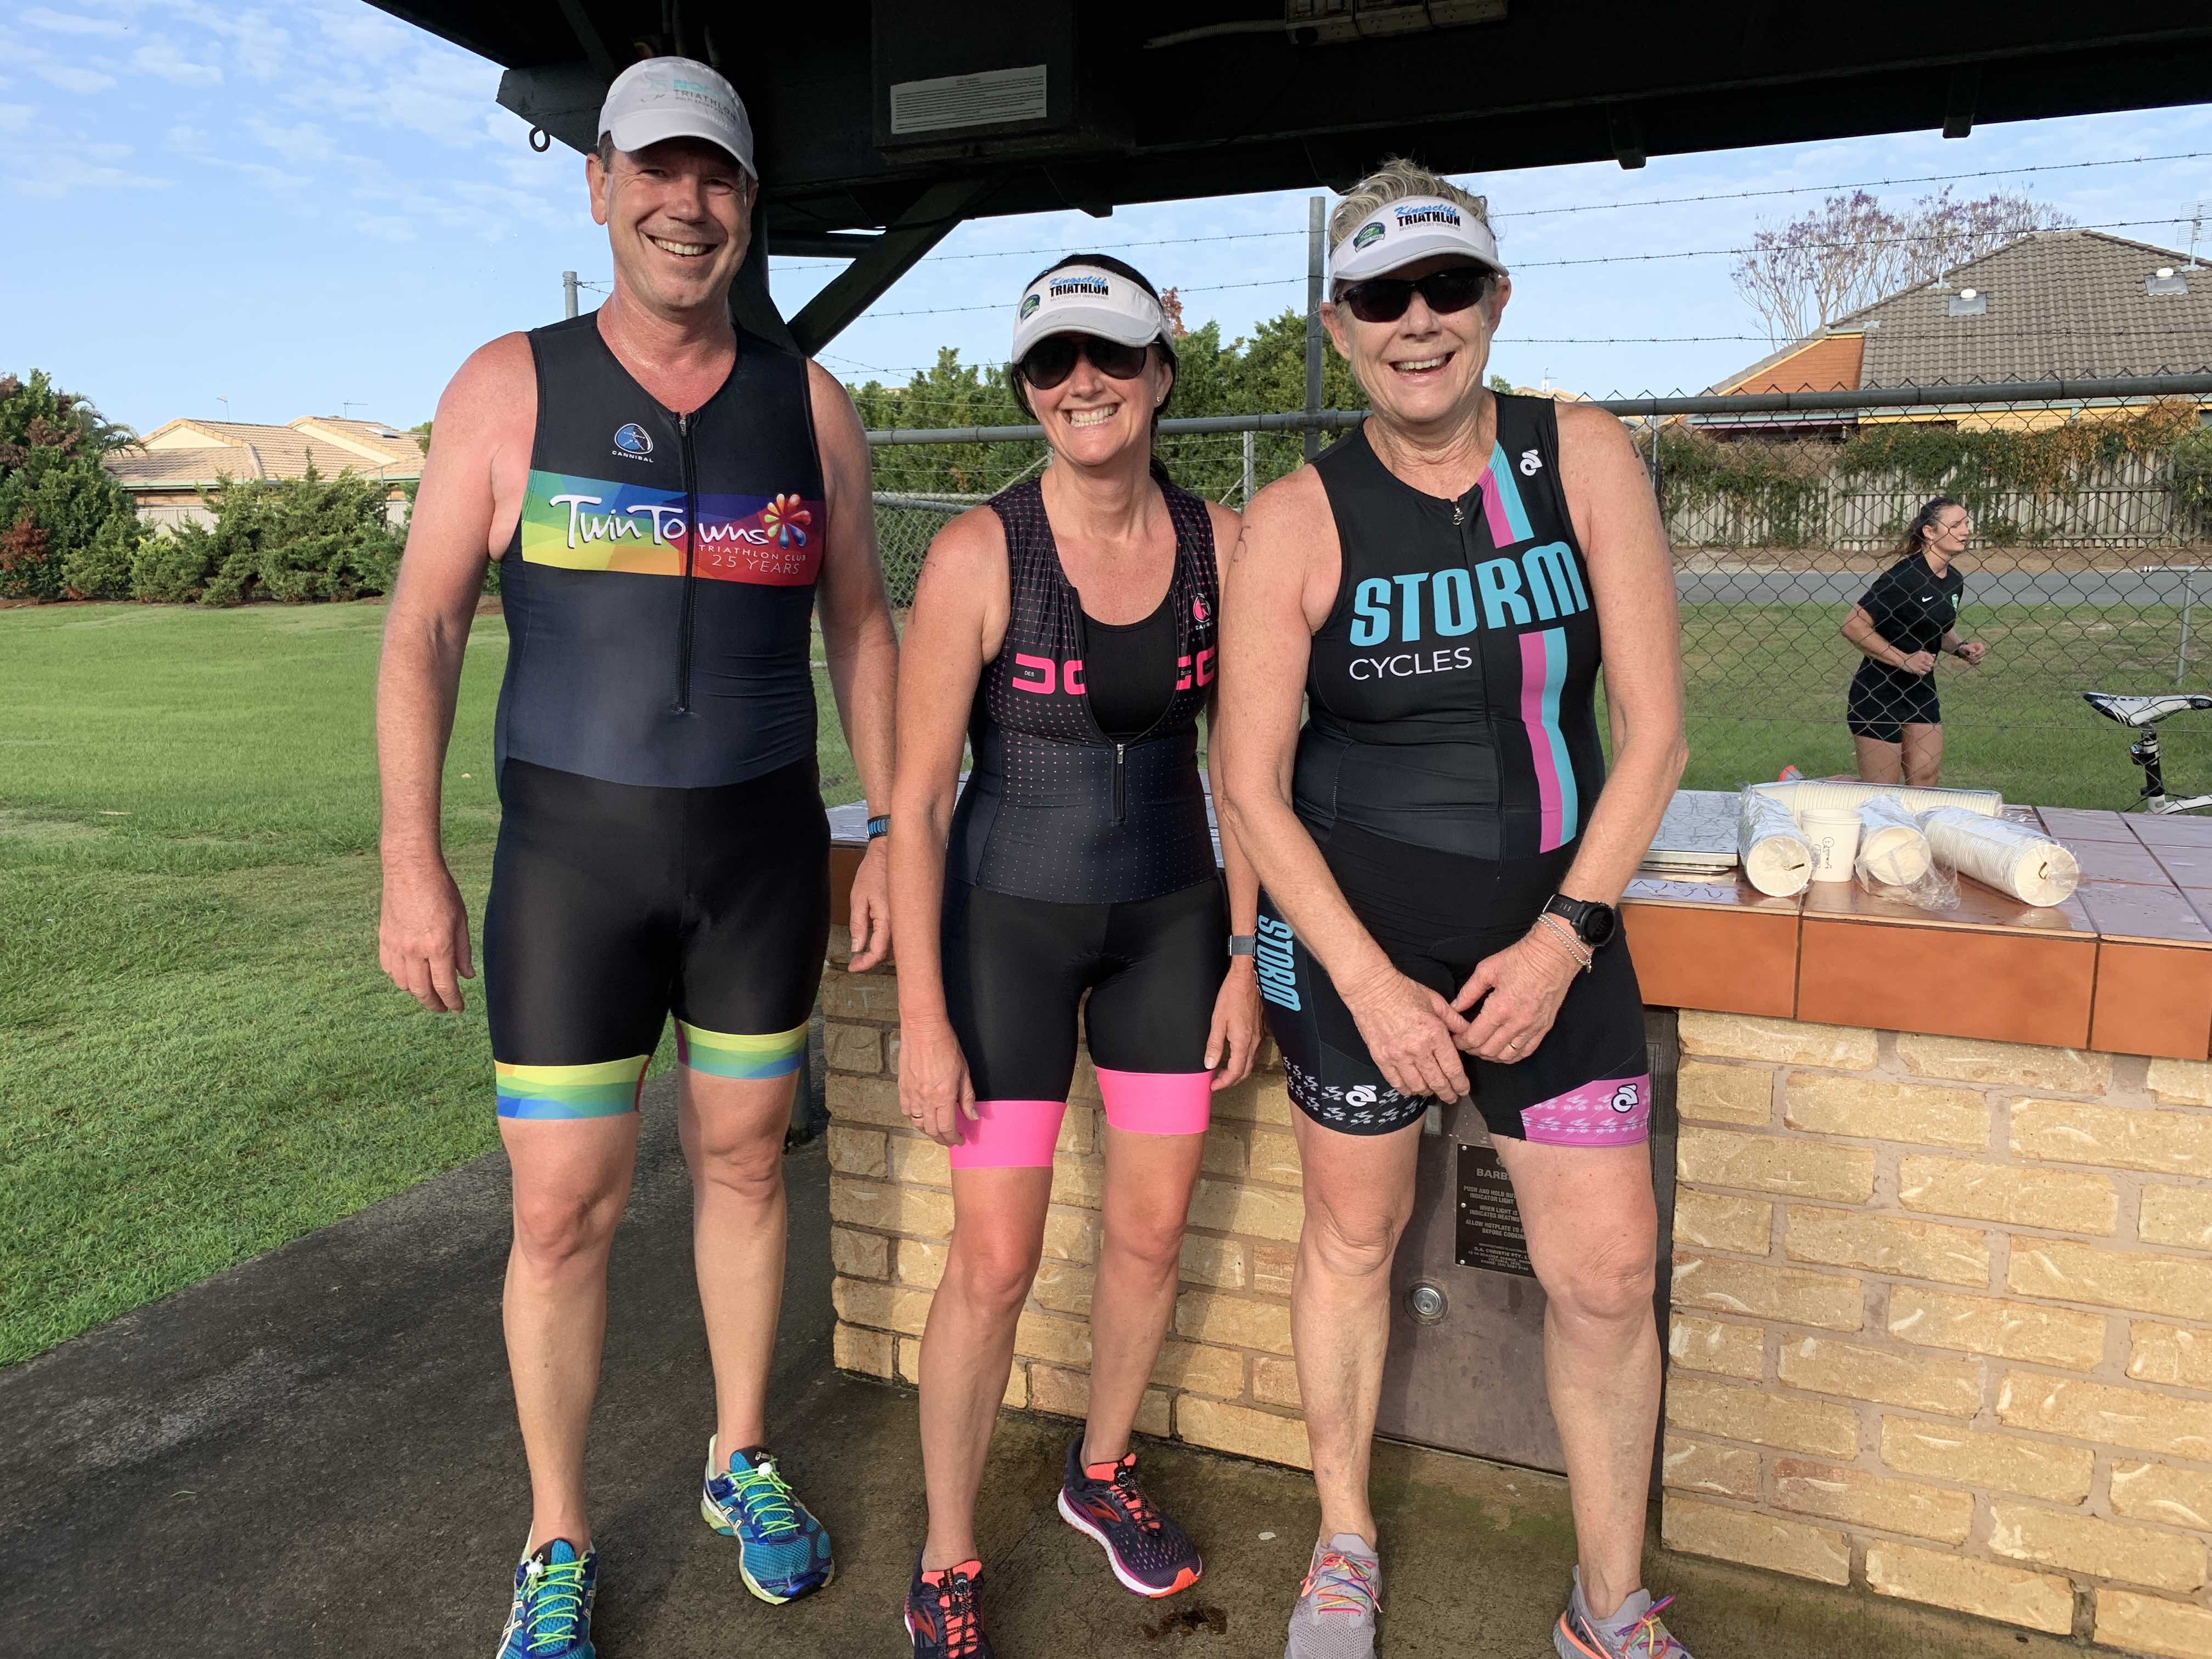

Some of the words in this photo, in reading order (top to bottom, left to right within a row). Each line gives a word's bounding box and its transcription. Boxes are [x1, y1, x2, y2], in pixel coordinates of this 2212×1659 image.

[674, 89, 736, 120] TRIATHLON
[1395, 204, 1457, 217] Kingscliff
[1397, 211, 1460, 227] TRIATHLON
[1049, 275, 1107, 288] Kingscliff
[1049, 283, 1108, 297] TRIATHLON
[612, 450, 654, 462] CANNIBAL
[549, 494, 642, 549] Twin
[698, 545, 778, 560] TRIATHLON
[712, 555, 737, 567] 25
[746, 558, 801, 574] YEARS
[1350, 541, 1589, 646] STORM
[1349, 646, 1472, 680] CYCLES
[1257, 915, 1301, 1011] STORM
[1470, 1193, 1497, 1202] INDICATOR
[1470, 1209, 1496, 1218] INDICATES
[1482, 1228, 1503, 1236] BEFORE
[1484, 1222, 1511, 1231] HOTPLATE
